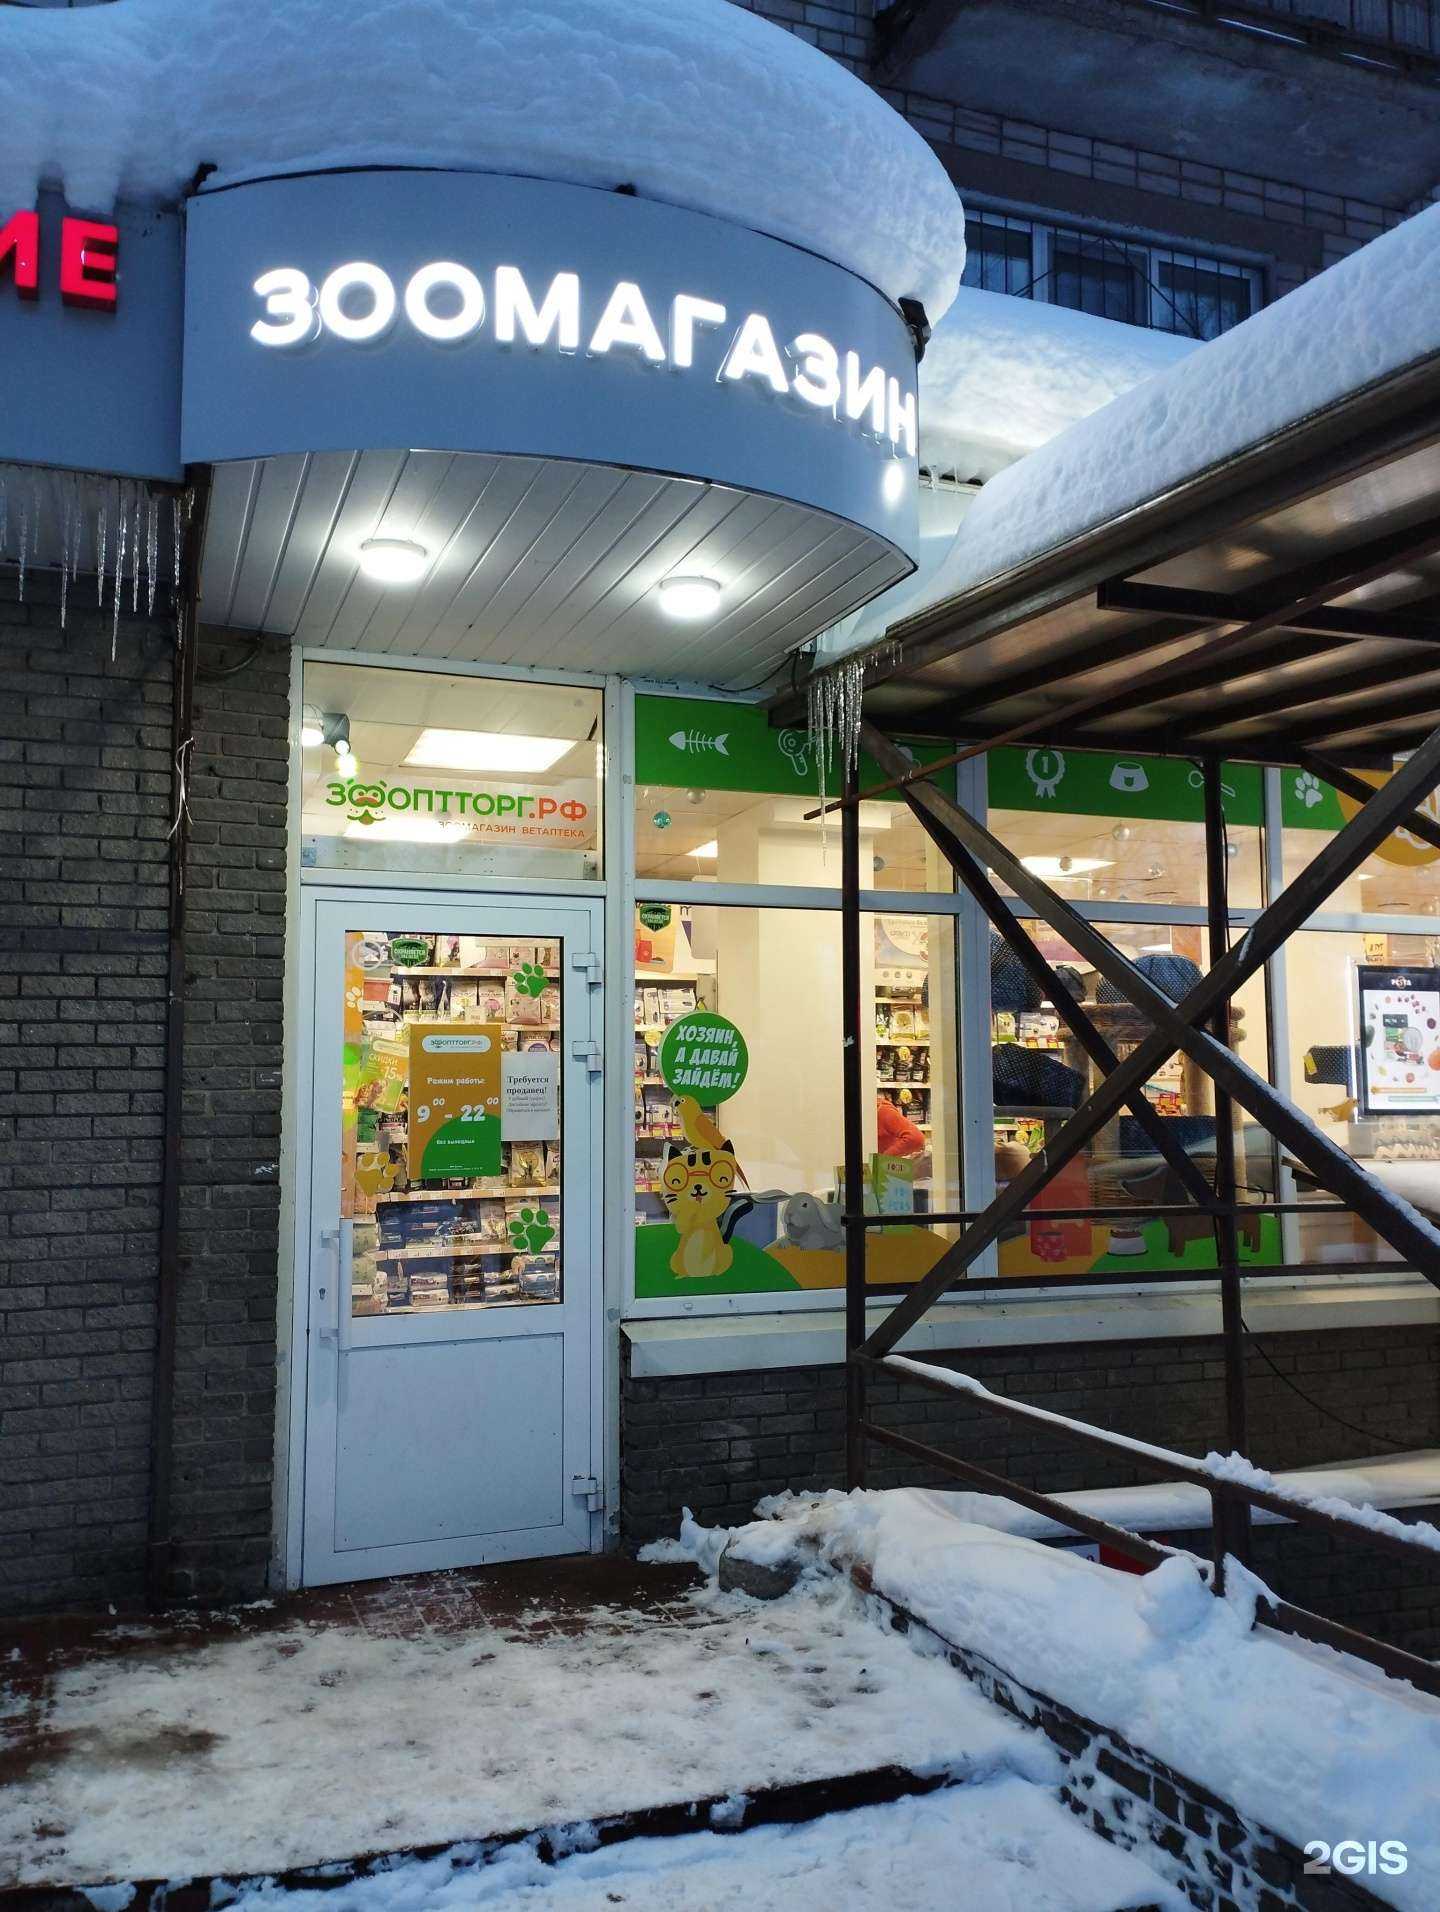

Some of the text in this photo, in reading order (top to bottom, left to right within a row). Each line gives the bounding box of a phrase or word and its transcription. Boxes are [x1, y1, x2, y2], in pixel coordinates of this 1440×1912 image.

[250, 261, 916, 458] ЗООМАГАЗИН
[438, 820, 585, 838] ЗАГАЗИН ВЕТАПТЕКА
[676, 1025, 738, 1048] ХОЗЯИН,
[674, 1047, 739, 1067] А ДАВАЙ
[507, 1075, 549, 1085] Требуется
[672, 1067, 741, 1089] ЗАЙДЁМ!
[506, 1086, 547, 1096] продавец!
